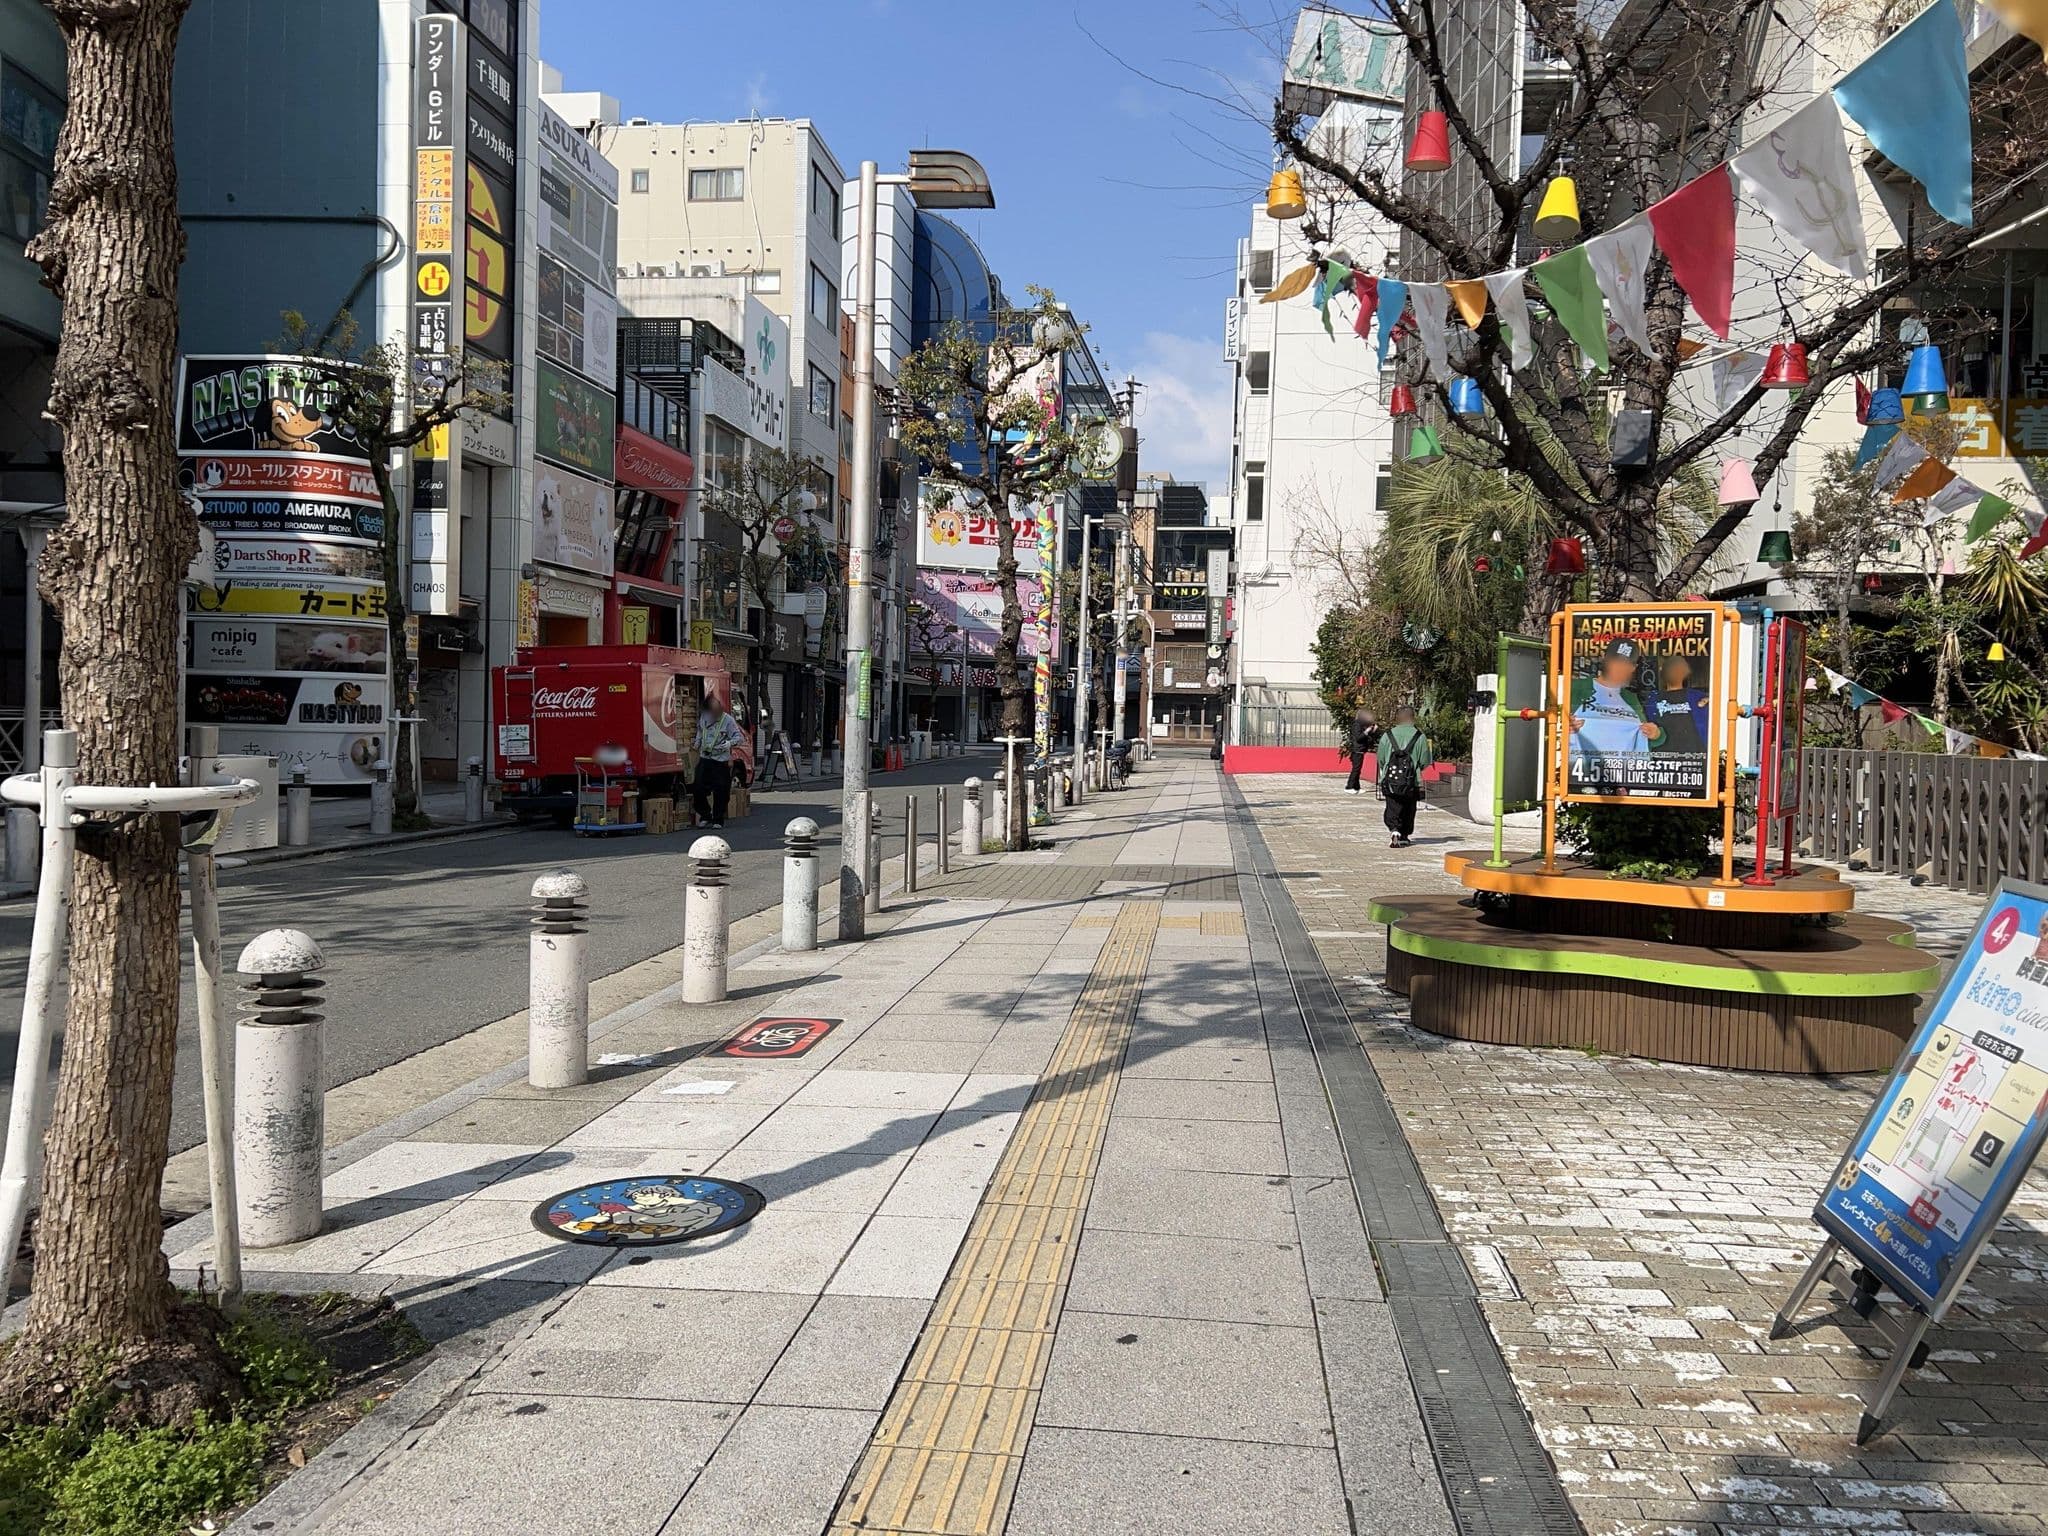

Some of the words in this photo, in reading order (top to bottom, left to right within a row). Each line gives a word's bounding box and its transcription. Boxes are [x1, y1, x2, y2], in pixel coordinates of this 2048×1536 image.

[428, 23, 444, 141] ワンダー6ビル
[475, 58, 510, 105] 千里眼
[469, 116, 514, 167] アメリカ村店
[541, 111, 592, 172] ASUKA
[424, 241, 444, 249] アップ
[423, 266, 445, 291] 占
[419, 312, 431, 349] 千里眼
[433, 307, 445, 353] 占いの館
[1227, 299, 1238, 358] クレインビル
[463, 435, 506, 460] ワンダー6ビル
[228, 463, 344, 482] リハーサルスタジオ
[205, 501, 248, 514] STUDIO
[252, 502, 280, 515] 1000
[284, 502, 352, 520] AMEMURA
[284, 521, 325, 531] BROADWAY
[328, 524, 352, 534] BRONX
[234, 549, 265, 561] Darts
[267, 549, 297, 565] Shop
[298, 548, 312, 564] R
[232, 580, 260, 589] Trading
[262, 580, 279, 588] card
[306, 581, 325, 591] shop
[413, 582, 445, 593] CHAOS
[300, 589, 385, 619] カード王
[211, 627, 257, 646] mipig
[1581, 617, 1625, 635] ASAD
[1629, 617, 1641, 634] &
[1644, 617, 1705, 635] SHAMS
[1662, 637, 1710, 657] JACK
[1571, 757, 1601, 783] 4.5
[1603, 758, 1623, 769] 2026
[1603, 768, 1623, 783] SUN
[1627, 759, 1682, 772] @BIGSTEP
[1627, 770, 1646, 784] LIVE
[1647, 771, 1675, 785] START
[1677, 772, 1703, 786] 18:00
[1991, 916, 2011, 945] 4F
[1966, 966, 2023, 1017] kino
[1978, 1034, 2018, 1061] 行き方ご案内
[1944, 1081, 1990, 1113] エレベーターで
